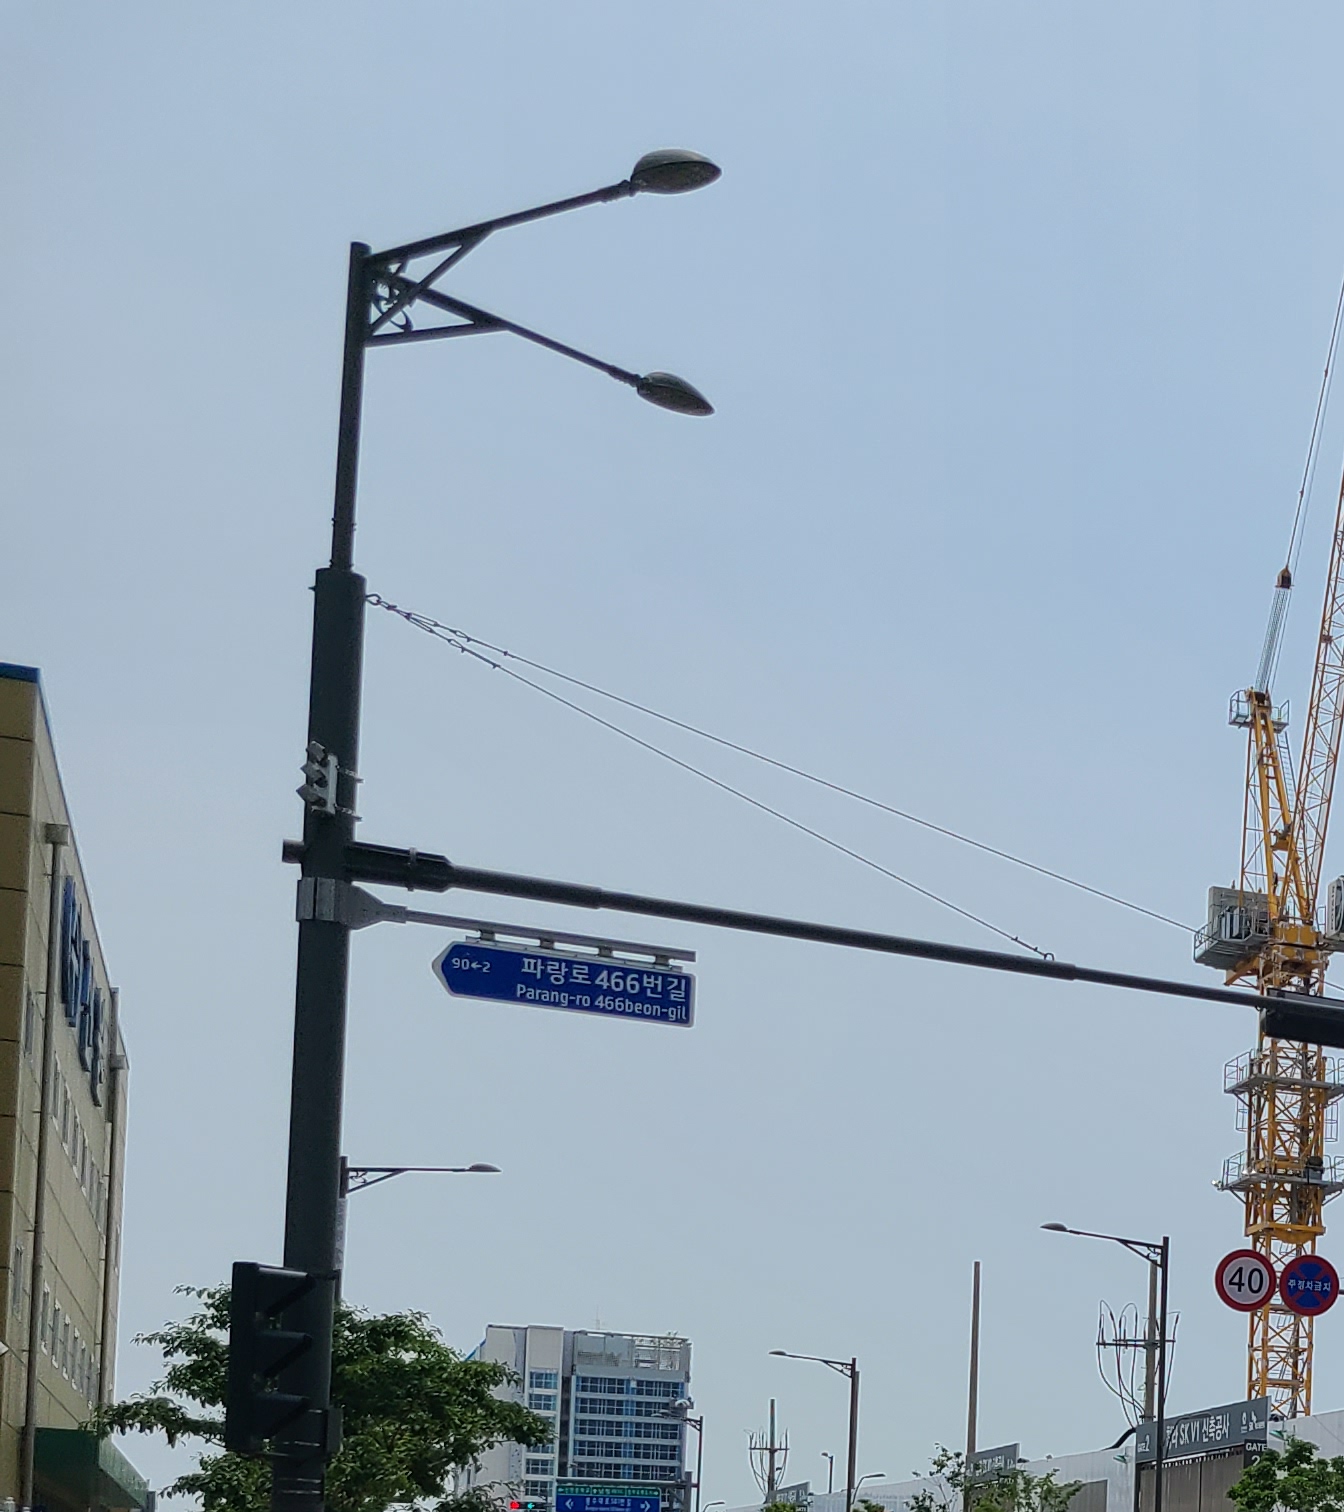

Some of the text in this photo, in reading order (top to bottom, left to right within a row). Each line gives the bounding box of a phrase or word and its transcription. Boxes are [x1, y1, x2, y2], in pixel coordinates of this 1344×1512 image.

[517, 984, 687, 1021] Parang-ro 466beon-gil
[1229, 1266, 1264, 1294] 40
[1288, 1279, 1331, 1292] 주정차금지
[1179, 1423, 1190, 1446] SK
[1202, 1413, 1230, 1443] 신축공사
[1246, 1442, 1267, 1451] GATE
